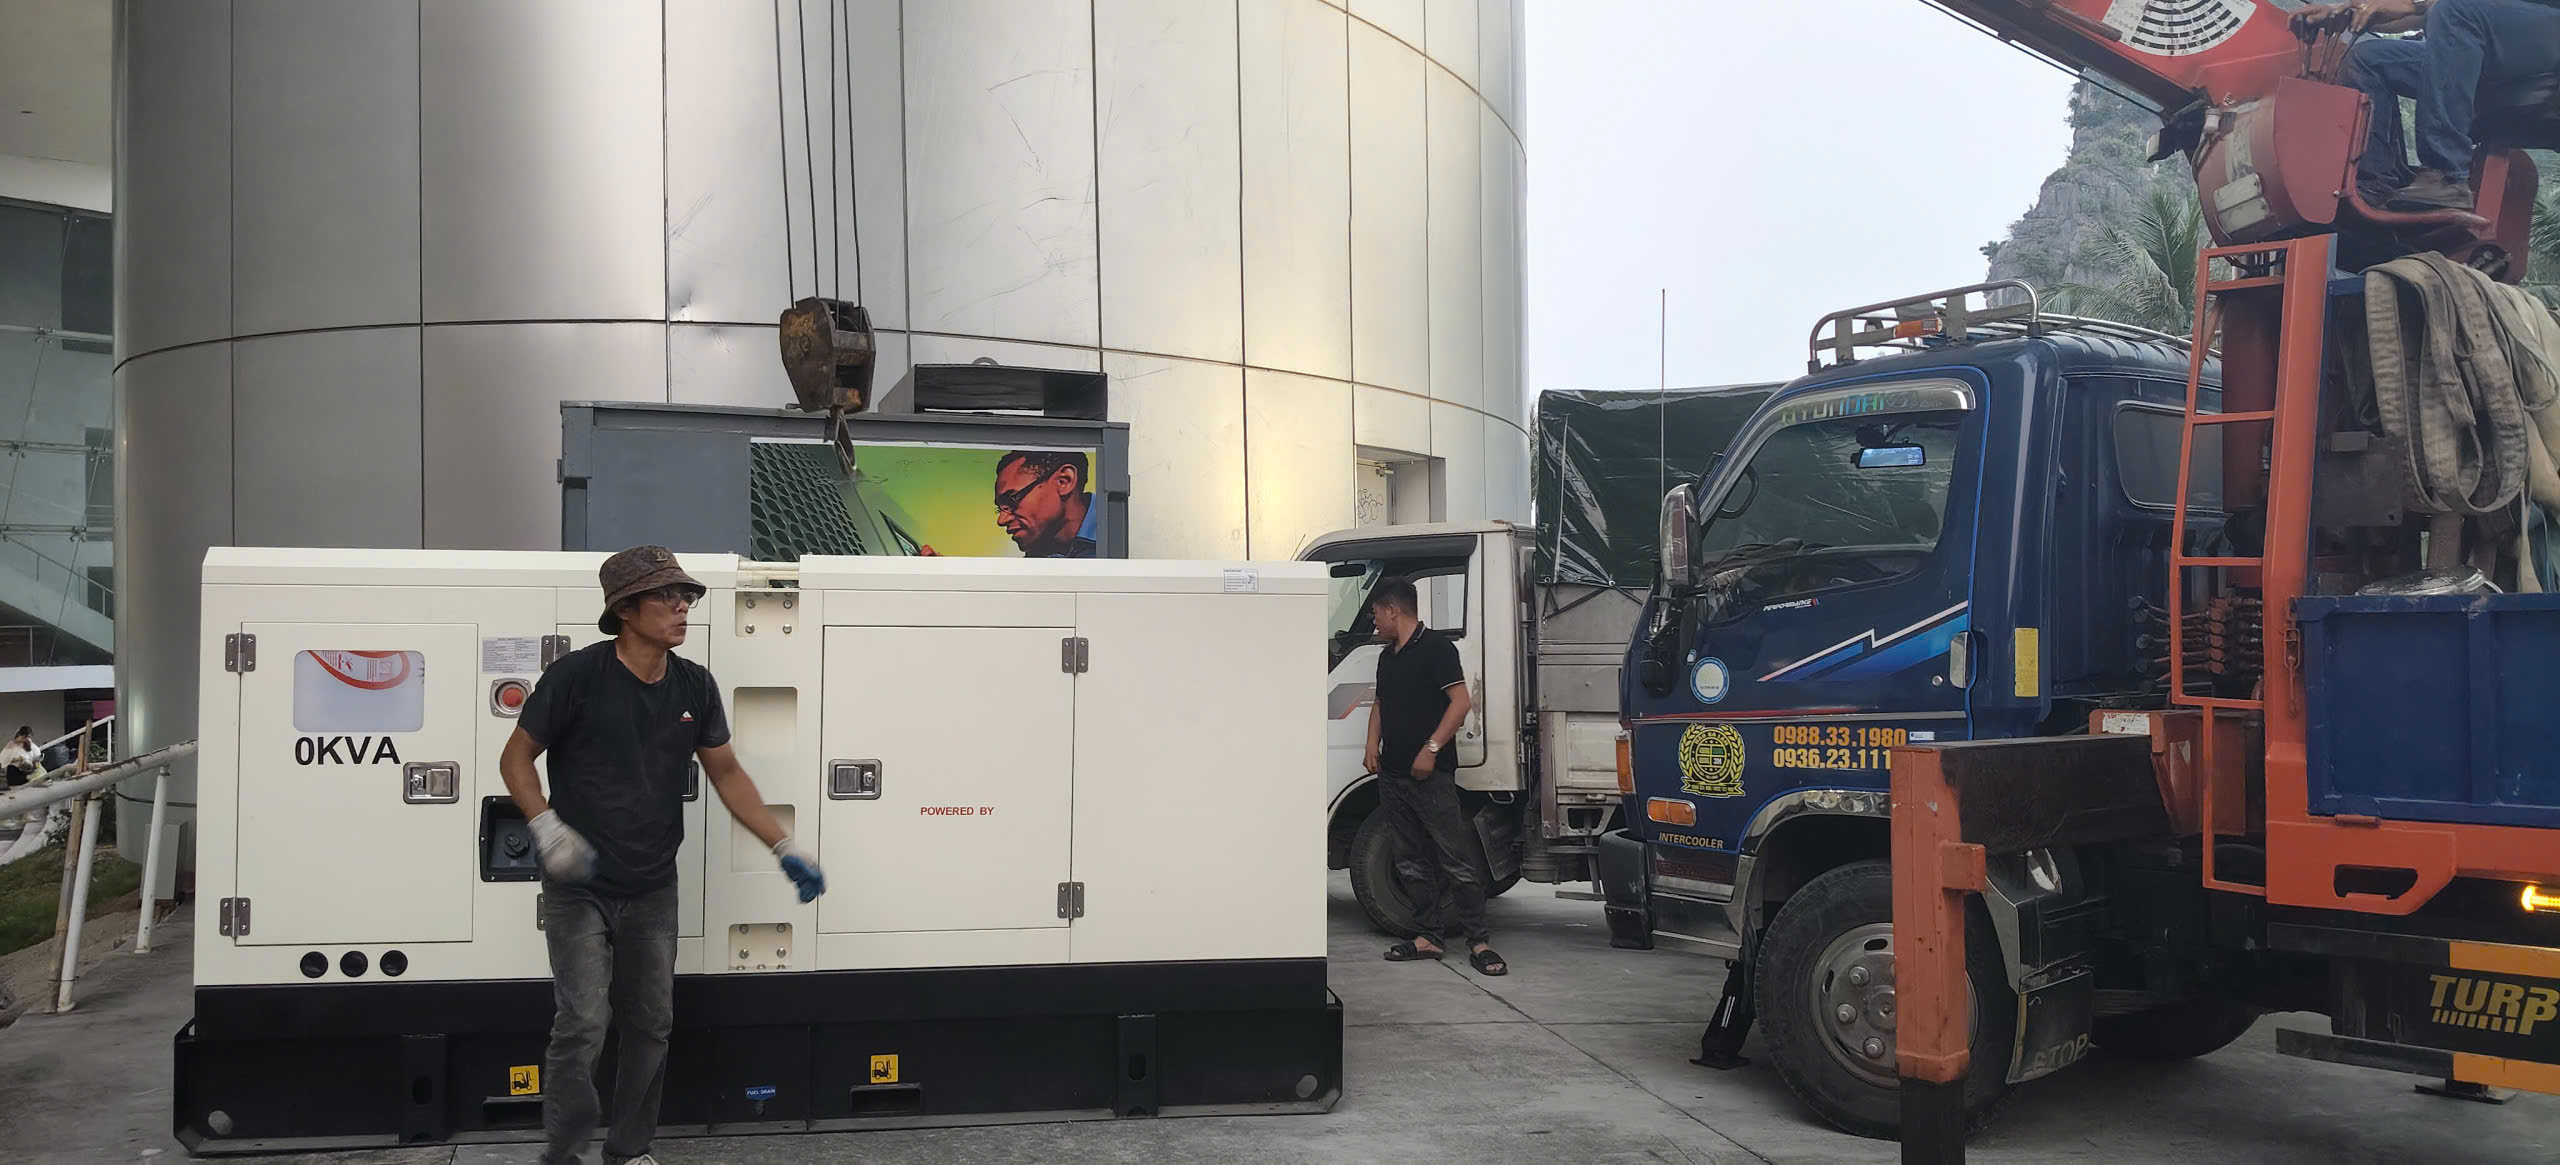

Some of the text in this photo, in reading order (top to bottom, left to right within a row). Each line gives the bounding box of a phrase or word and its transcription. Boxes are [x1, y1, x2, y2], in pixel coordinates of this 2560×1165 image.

[1773, 726, 1907, 747] 0988.33.1980
[920, 806, 995, 816] POWERED BY
[1658, 832, 1724, 849] INTERCOOLER
